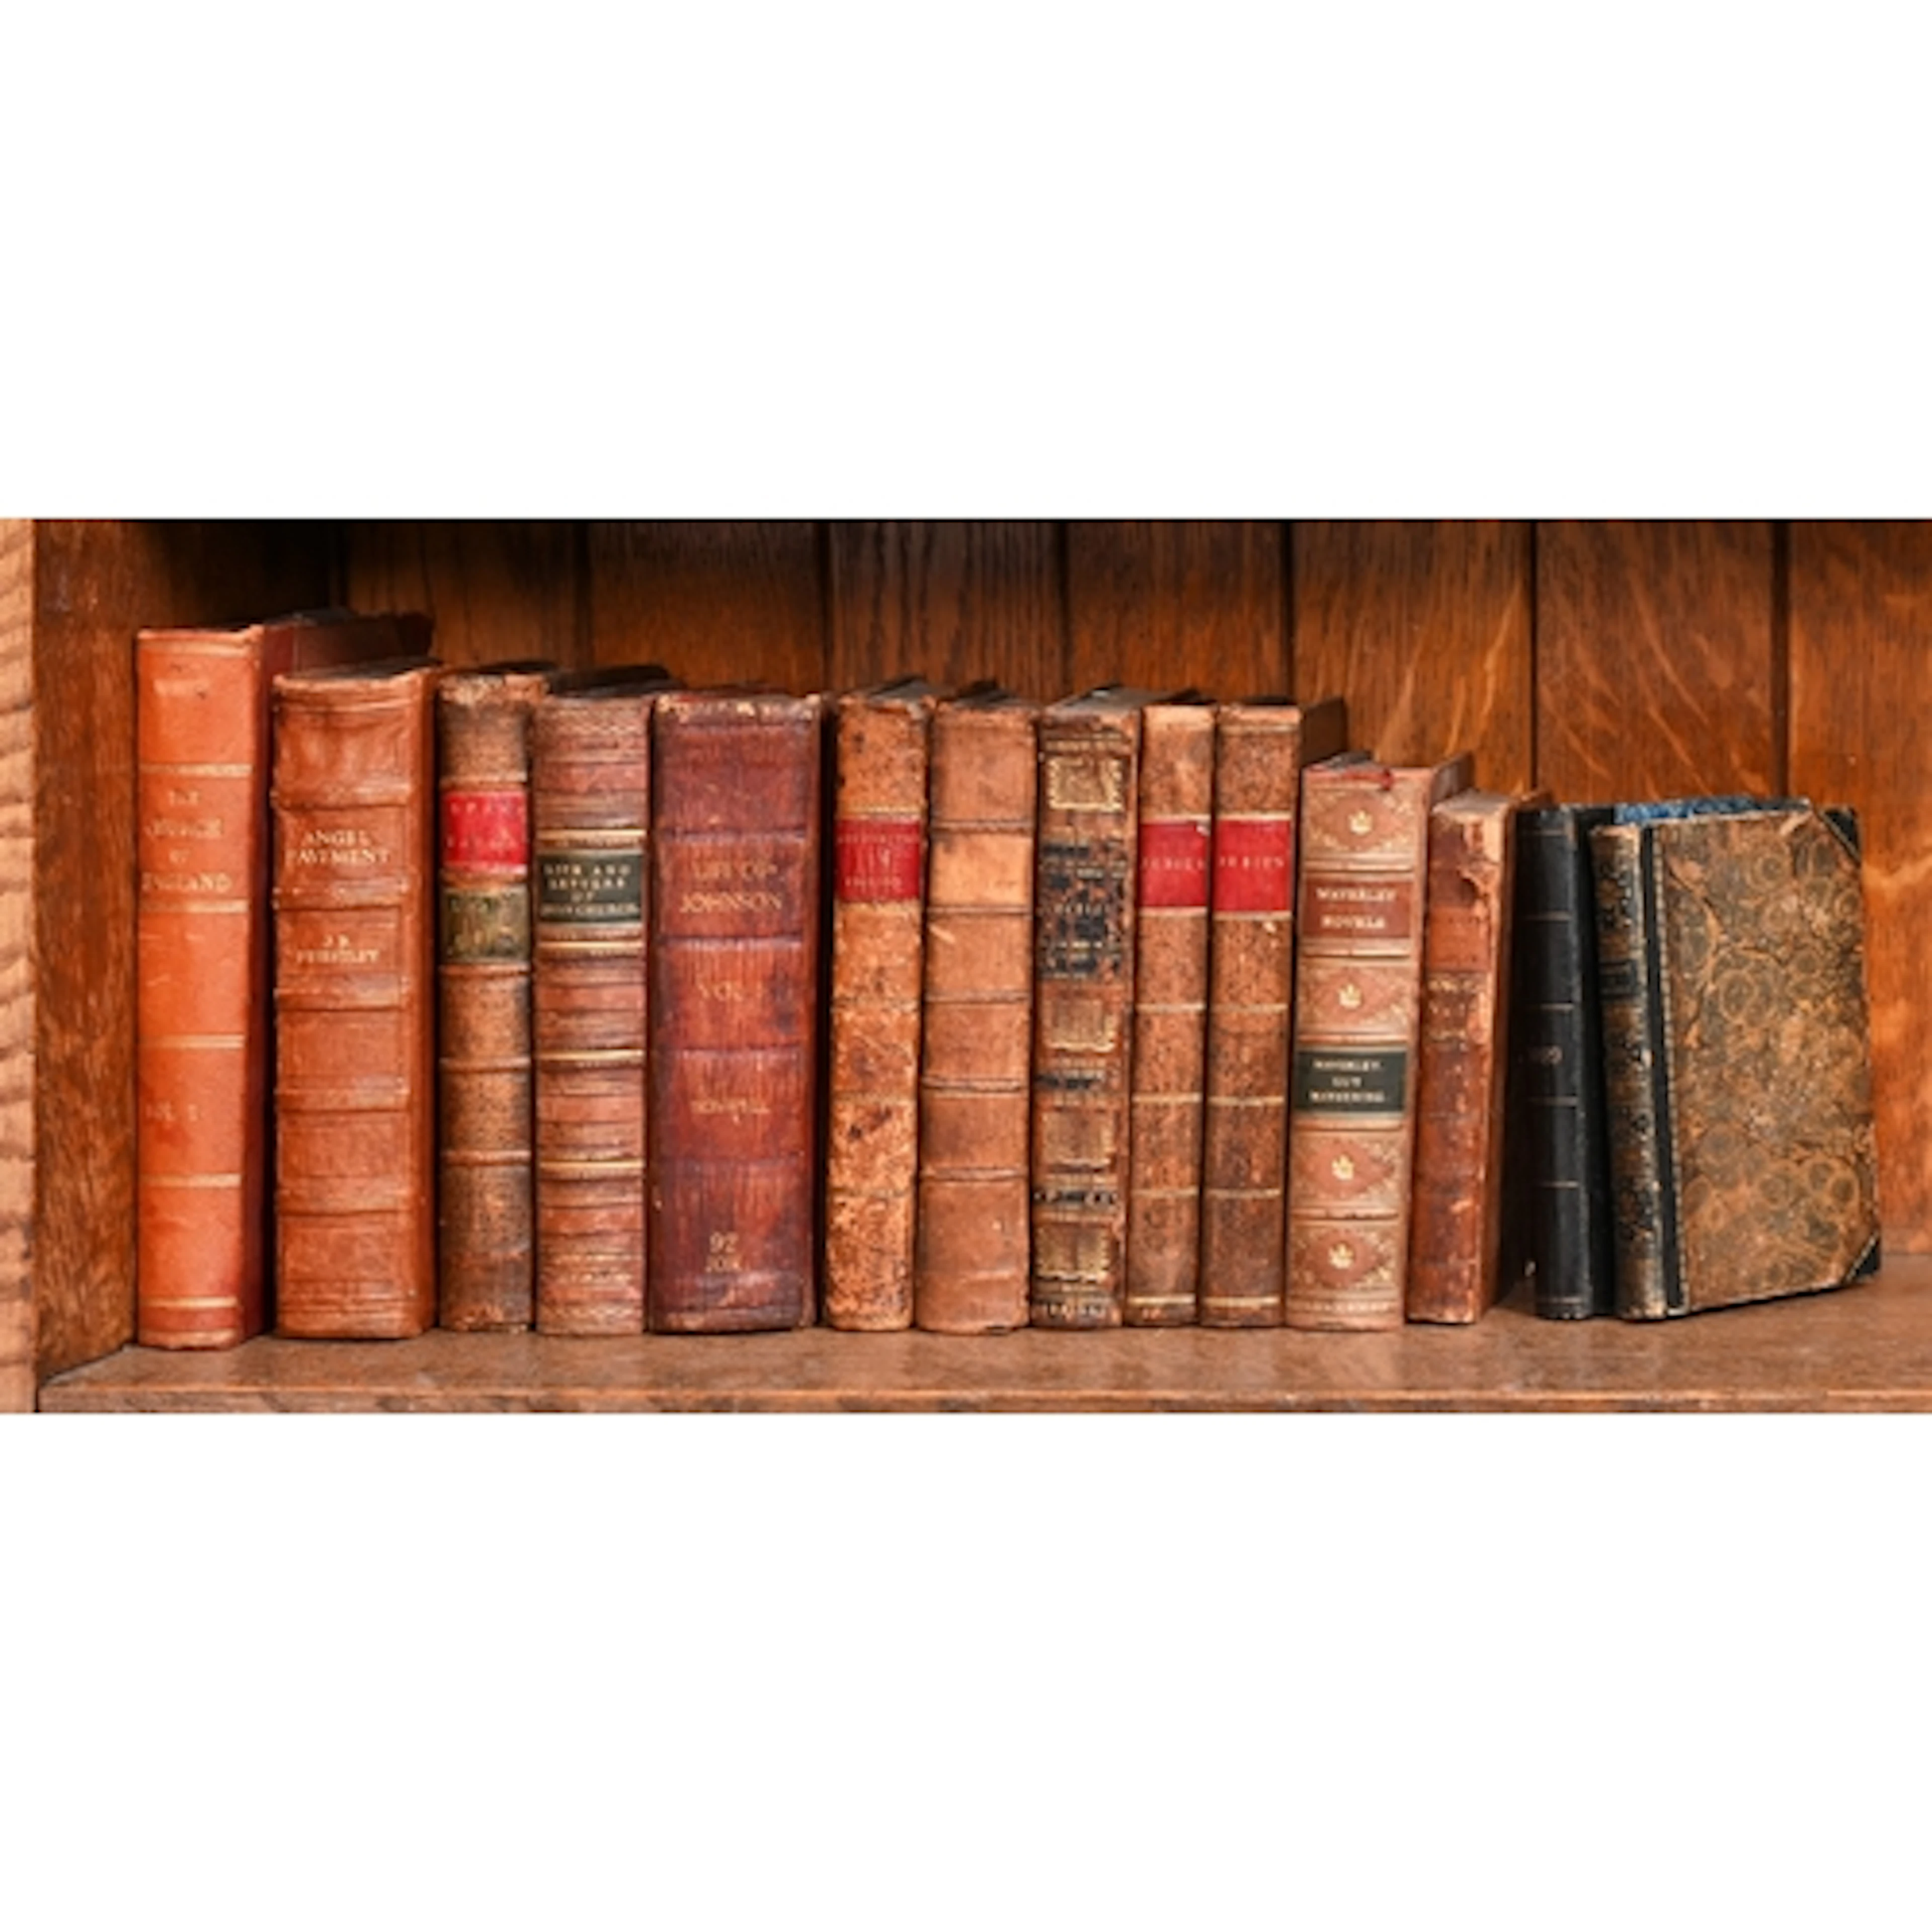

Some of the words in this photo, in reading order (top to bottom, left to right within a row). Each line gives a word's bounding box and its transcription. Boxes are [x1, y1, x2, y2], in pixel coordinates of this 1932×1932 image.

[302, 830, 372, 847] ANGEL
[285, 849, 390, 864] PAVEMENT
[679, 892, 783, 913] JOHNSON
[1316, 888, 1397, 902] WAVERLEY
[1320, 914, 1386, 929] NOVELS
